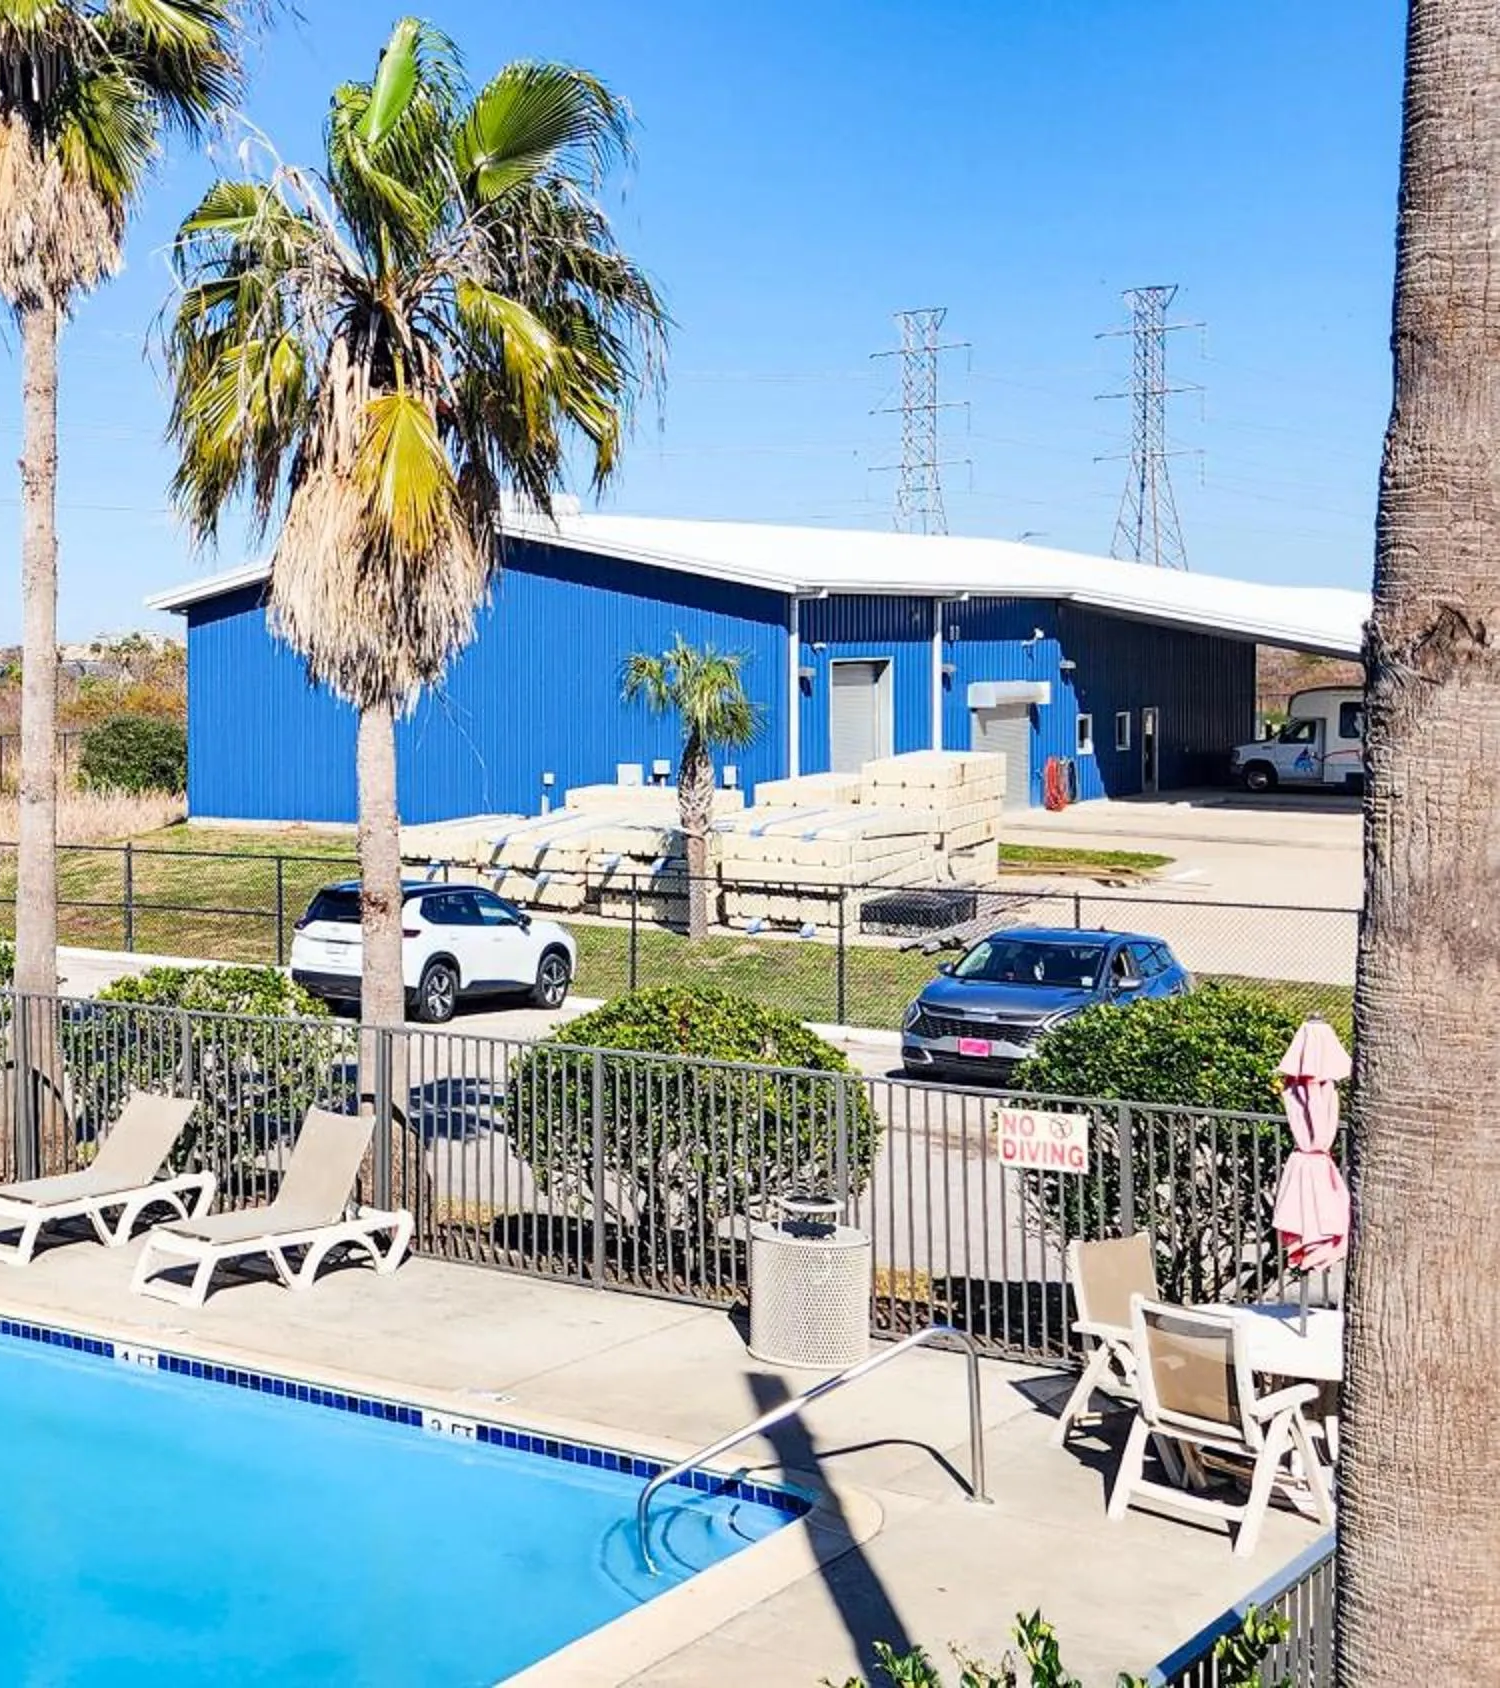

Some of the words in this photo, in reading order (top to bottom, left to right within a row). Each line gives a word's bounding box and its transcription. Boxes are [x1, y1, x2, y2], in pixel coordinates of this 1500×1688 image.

[1002, 1112, 1035, 1137] NO
[1003, 1138, 1084, 1168] DIVING
[137, 1353, 155, 1367] FT
[451, 1423, 474, 1438] FT
